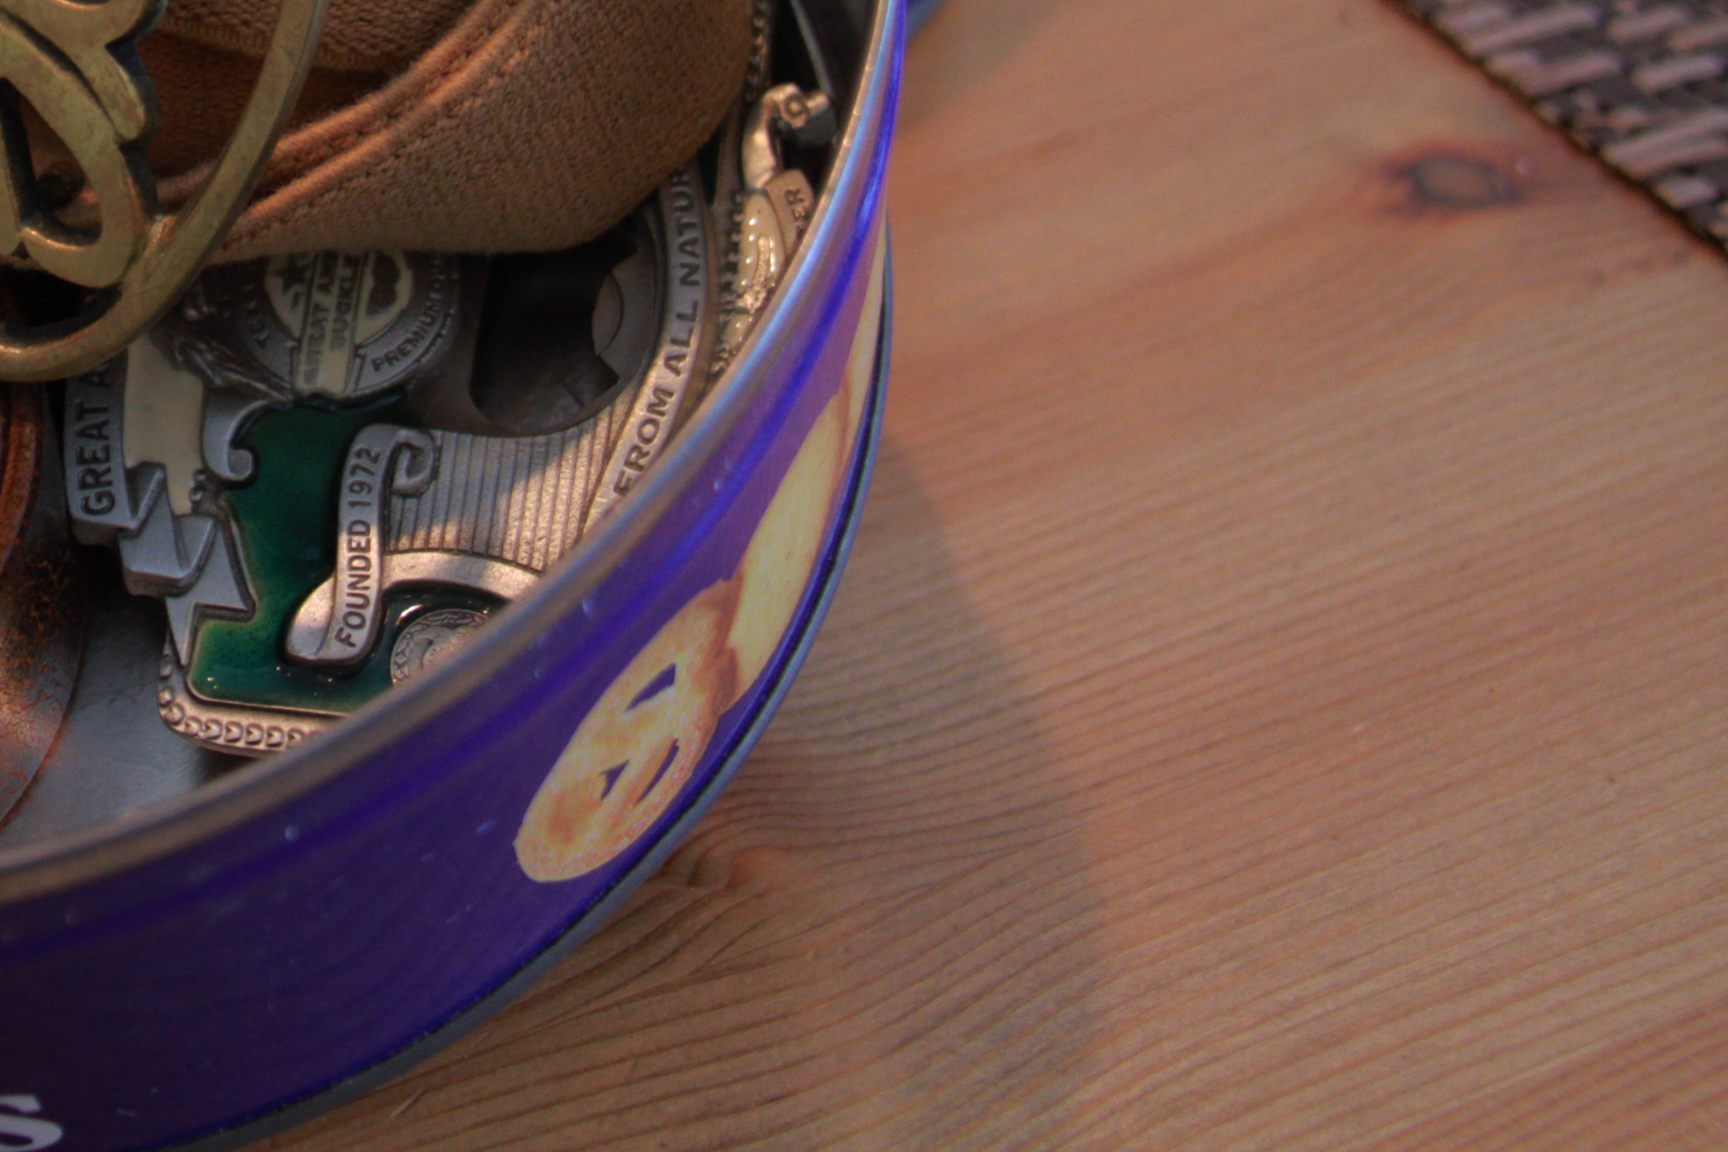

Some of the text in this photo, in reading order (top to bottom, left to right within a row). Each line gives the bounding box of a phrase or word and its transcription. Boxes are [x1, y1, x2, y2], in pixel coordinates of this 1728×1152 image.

[72, 400, 117, 517] GREAT
[613, 386, 676, 498] FROM
[663, 301, 699, 379] ALL
[334, 448, 381, 648] FOUNDED 1972
